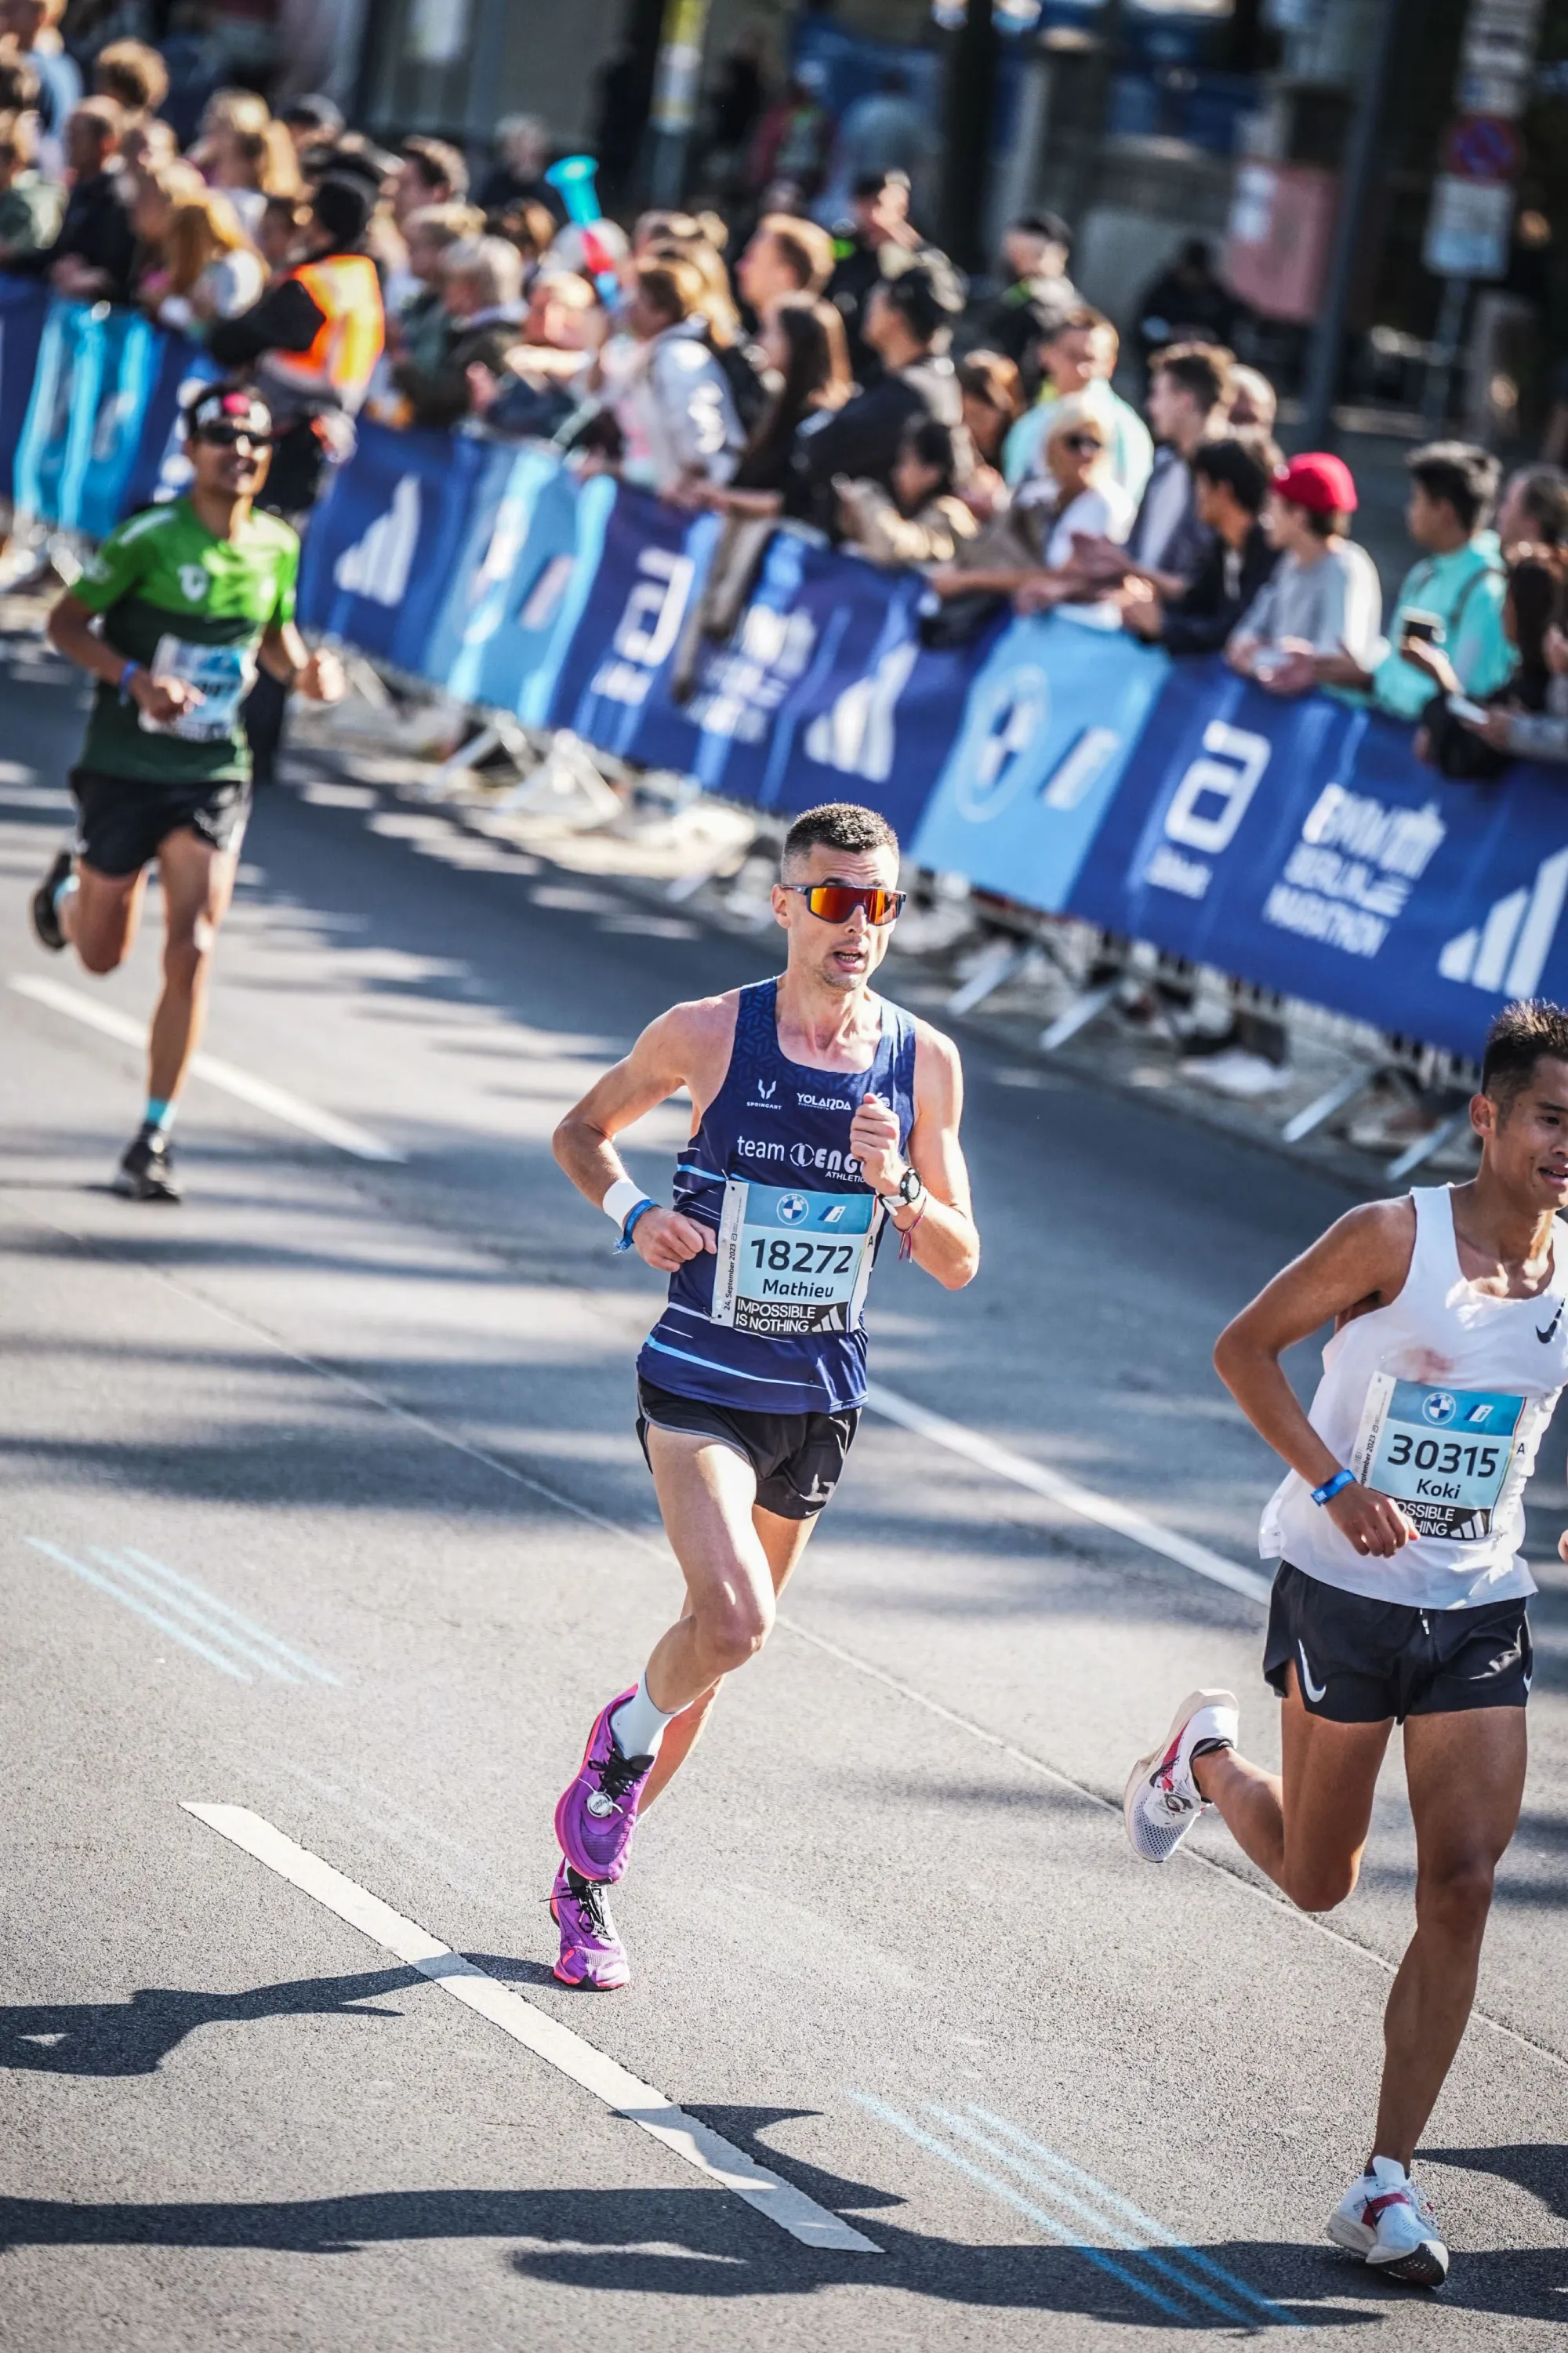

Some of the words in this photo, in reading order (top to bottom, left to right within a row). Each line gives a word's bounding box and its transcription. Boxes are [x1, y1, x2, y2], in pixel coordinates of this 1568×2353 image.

[746, 1101, 782, 1110] SPRINGART
[797, 1092, 851, 1111] YOLANDA
[737, 1135, 785, 1162] team
[789, 1142, 866, 1175] LENG
[867, 1235, 873, 1248] A
[750, 1238, 854, 1274] 18272
[725, 1261, 735, 1298] September
[762, 1278, 834, 1298] Mathieu
[737, 1298, 817, 1320] IMPOSSIBLE
[735, 1313, 748, 1326] IS
[749, 1317, 810, 1333] NOTHING
[1387, 1433, 1500, 1478] 30315
[1516, 1443, 1526, 1455] A
[1360, 1454, 1372, 1487] eptember
[1367, 1434, 1376, 1453] 2023
[1416, 1478, 1461, 1500] Koki
[1396, 1501, 1456, 1522] OSSIBLE
[1414, 1519, 1448, 1536] HING
